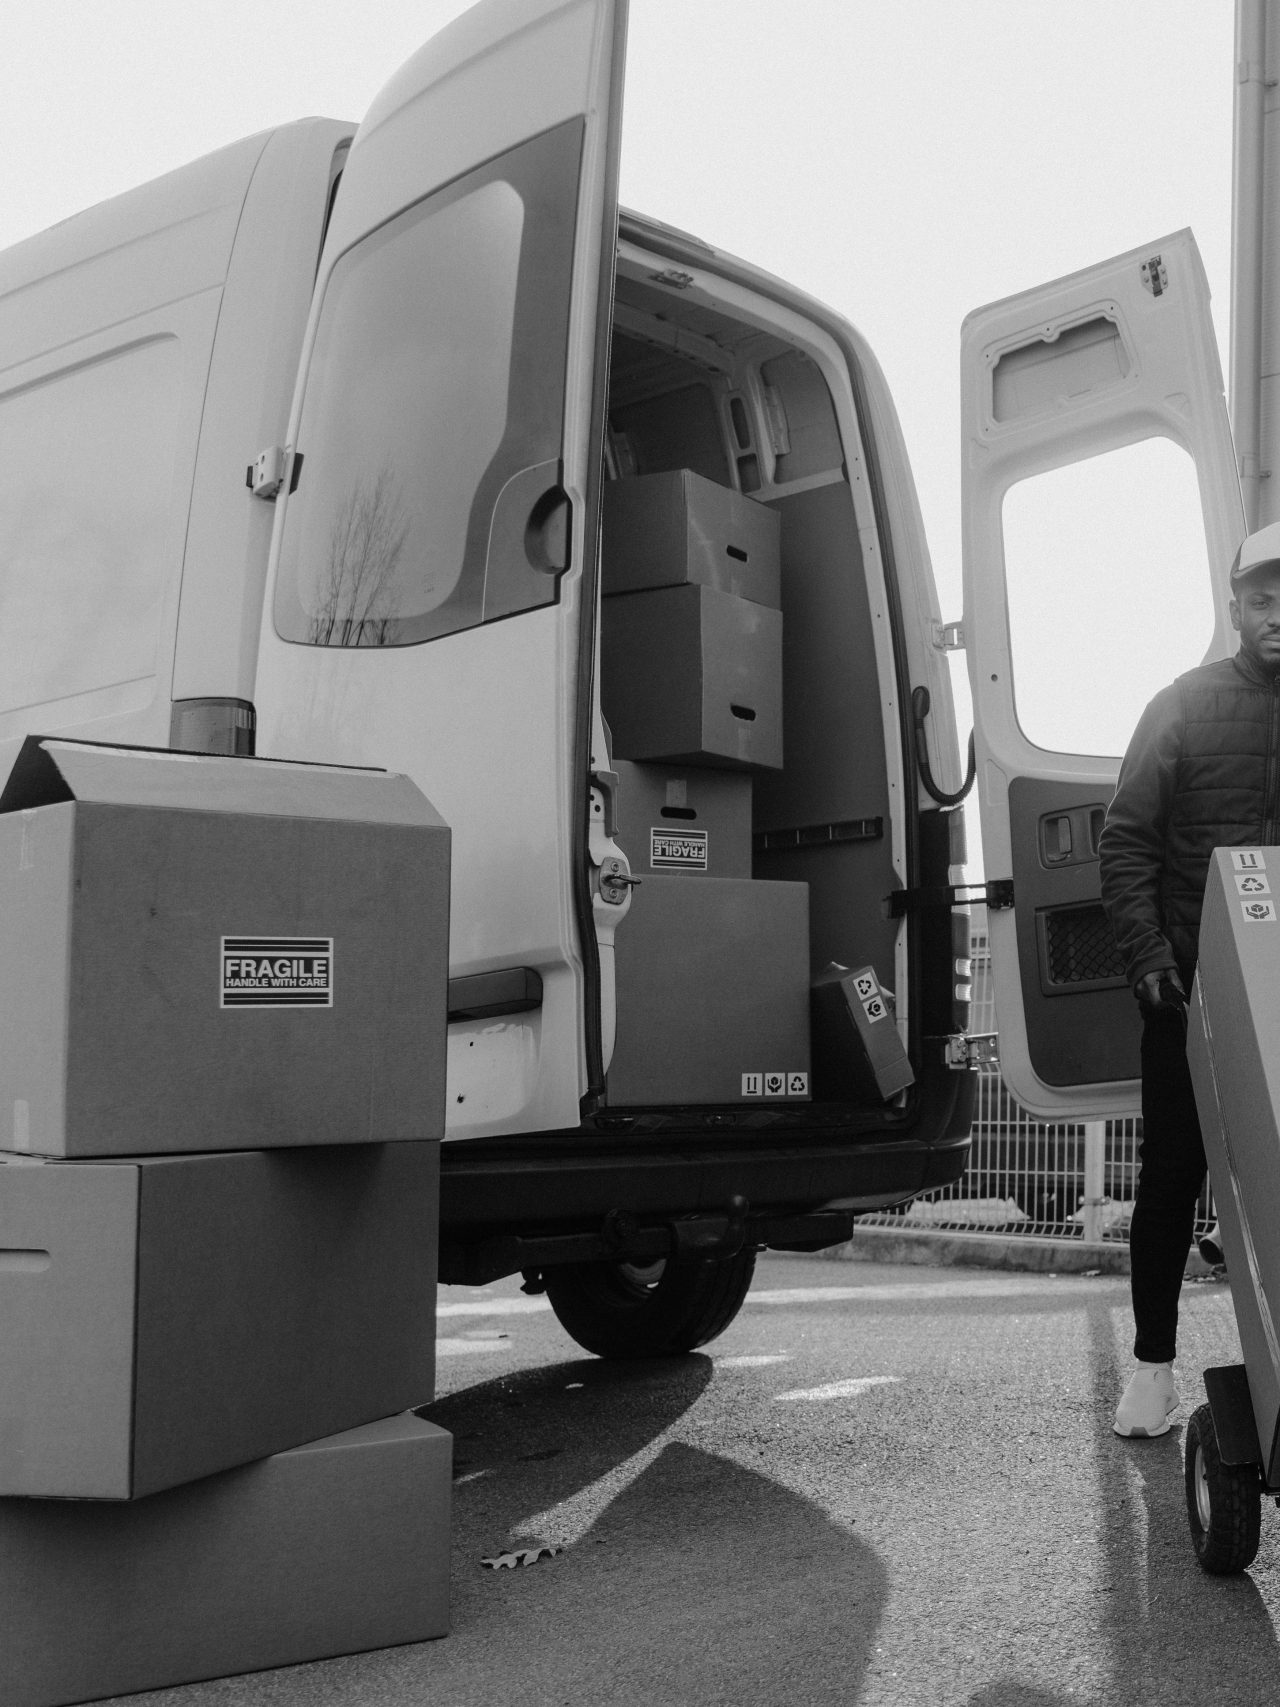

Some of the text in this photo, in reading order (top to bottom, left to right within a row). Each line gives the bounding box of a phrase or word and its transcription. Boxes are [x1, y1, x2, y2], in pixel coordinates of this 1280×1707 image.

[654, 845, 705, 858] FRAGILE
[225, 959, 327, 978] FRAGILE
[226, 978, 327, 987] HANDLE WITH CARE
